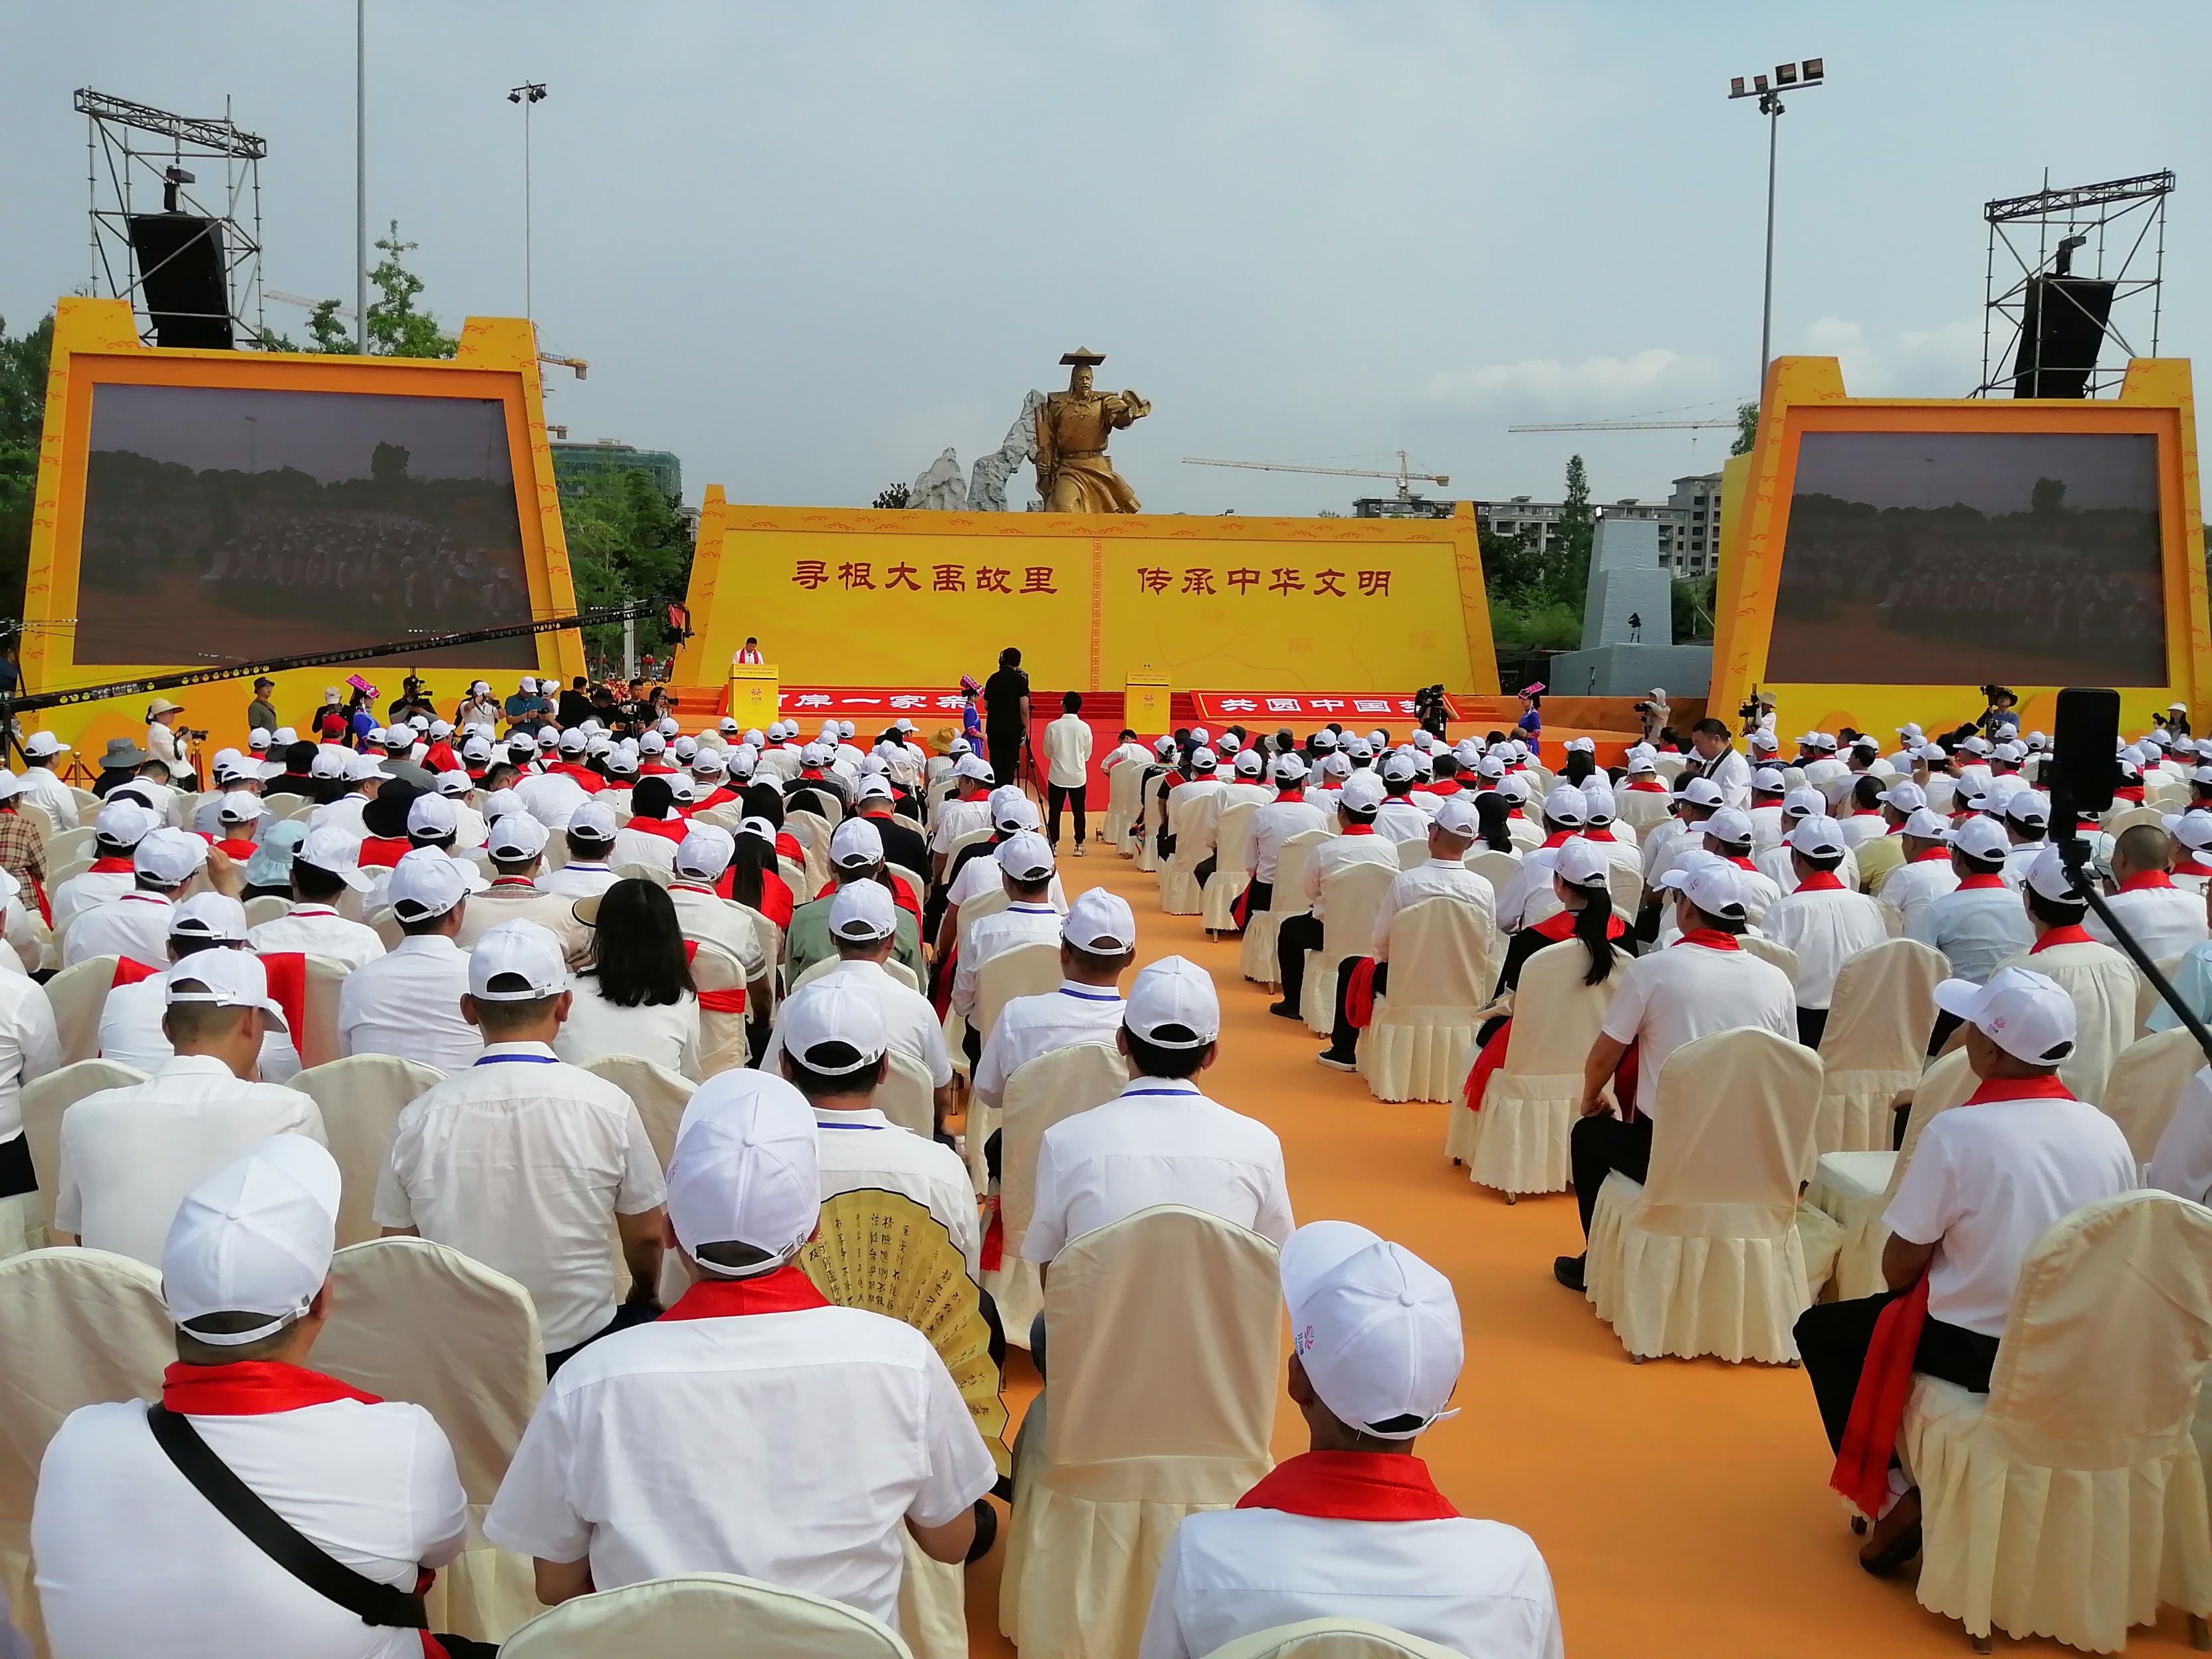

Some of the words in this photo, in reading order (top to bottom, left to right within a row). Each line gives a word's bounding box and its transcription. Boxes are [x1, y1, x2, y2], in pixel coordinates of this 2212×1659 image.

[793, 561, 1058, 594] 寻根大禹故里
[1139, 568, 1392, 598] 传承中华文明
